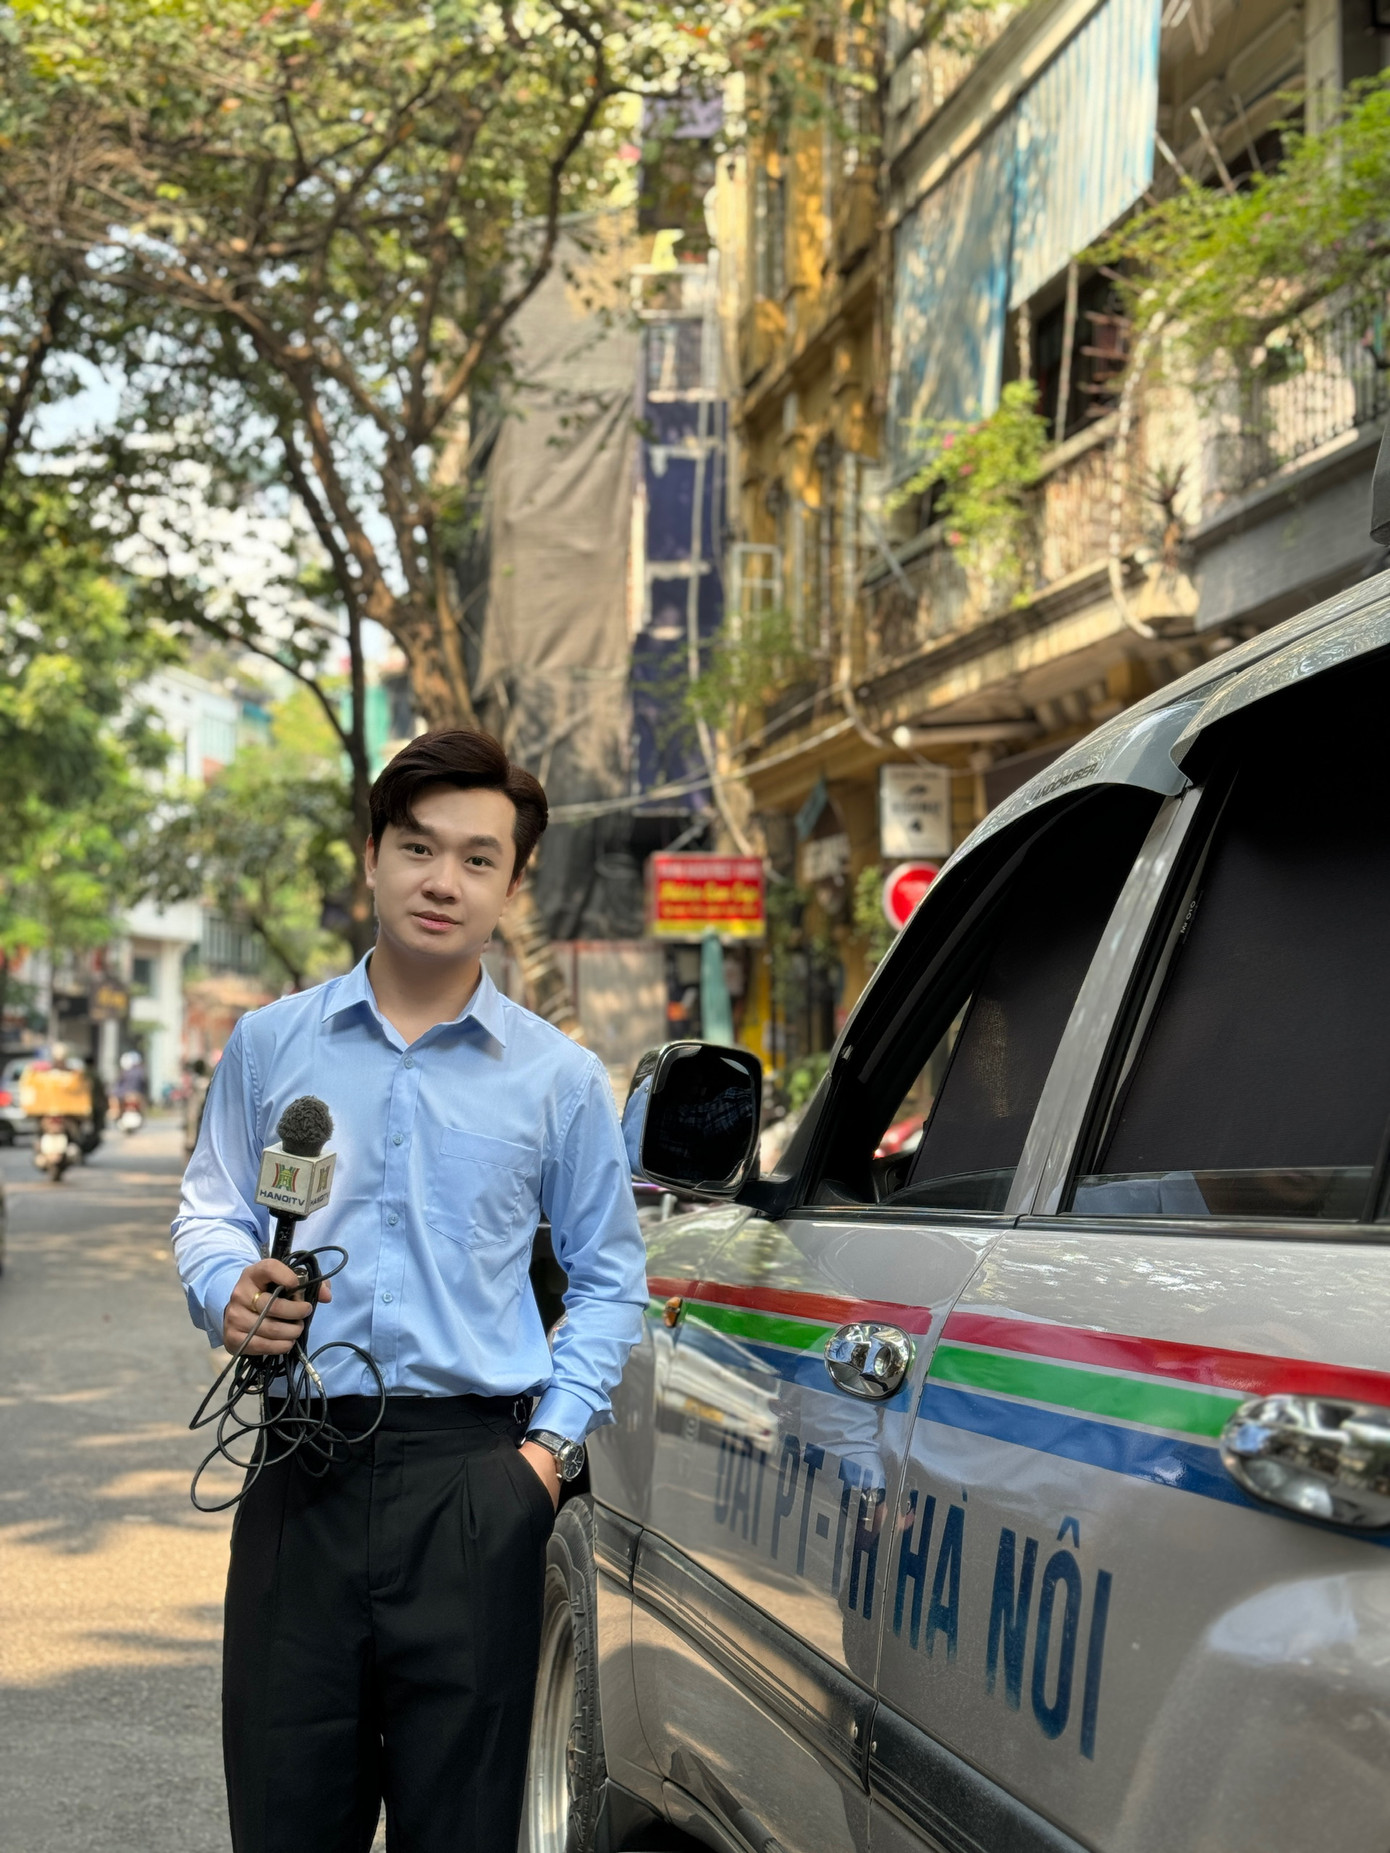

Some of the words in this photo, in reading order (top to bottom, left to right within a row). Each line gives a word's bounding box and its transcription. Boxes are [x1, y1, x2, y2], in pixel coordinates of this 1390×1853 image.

[259, 1189, 306, 1207] HANOITV
[770, 1433, 887, 1621] PT-TH
[893, 1488, 968, 1664] HÀ
